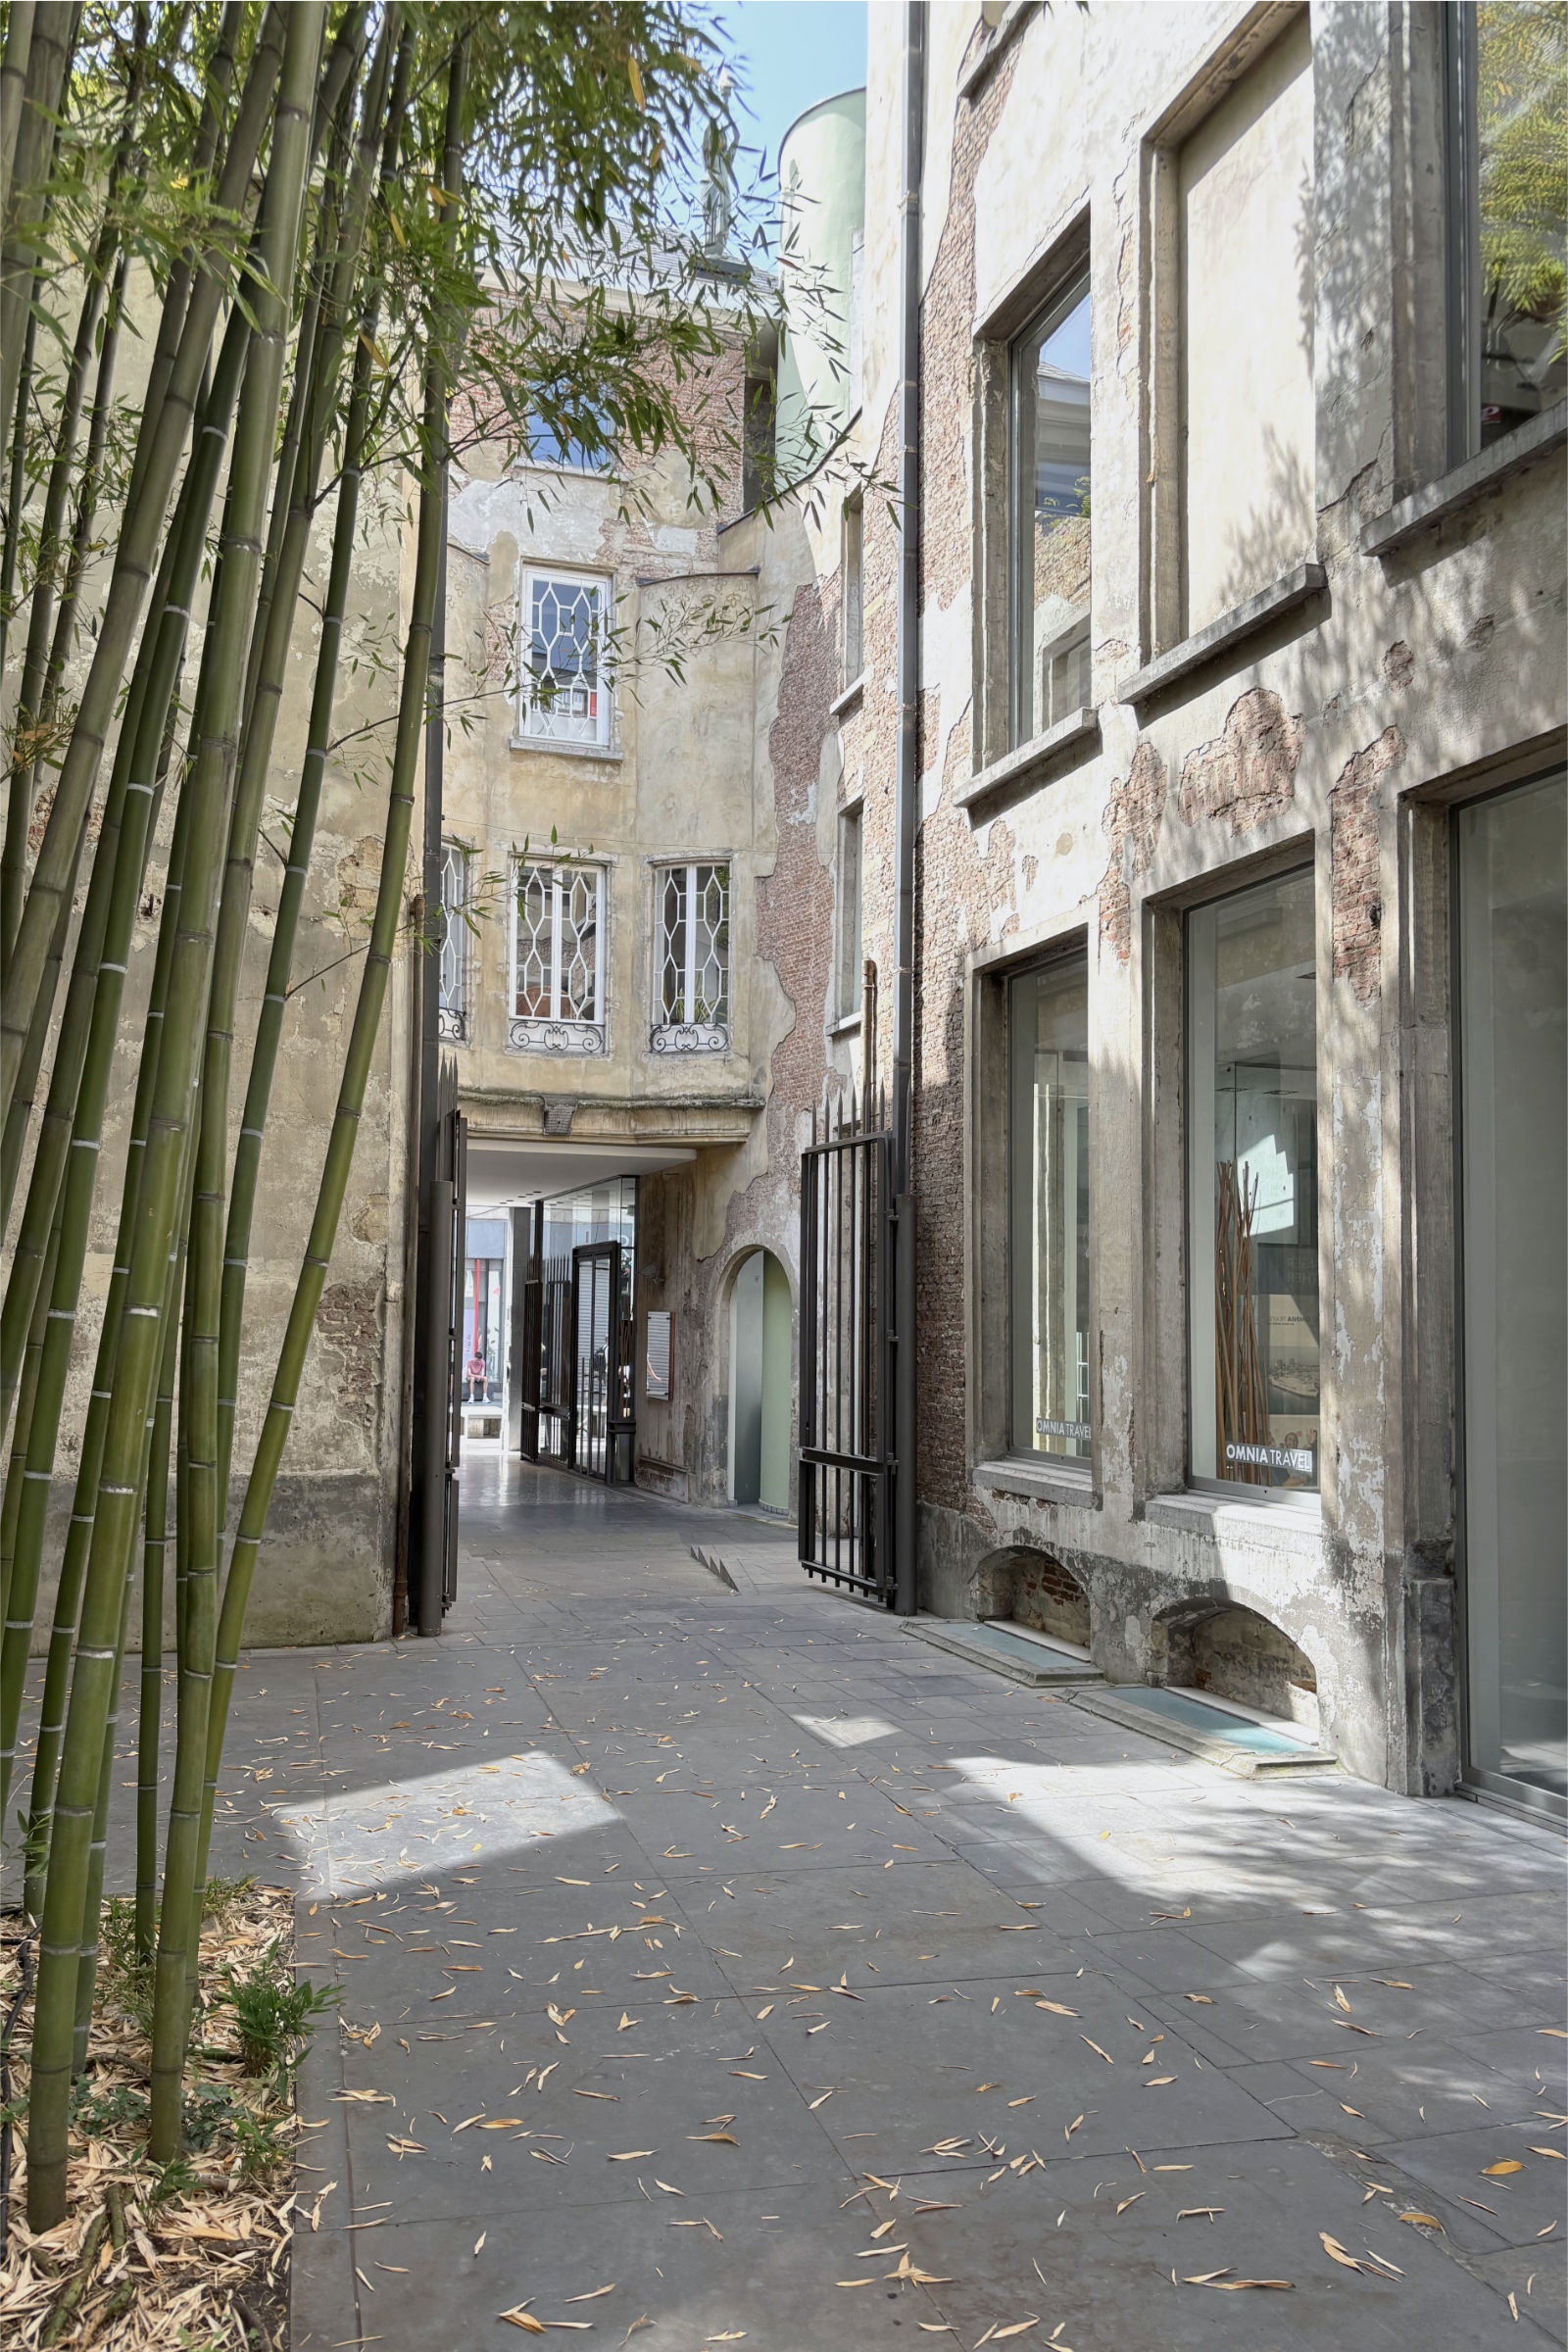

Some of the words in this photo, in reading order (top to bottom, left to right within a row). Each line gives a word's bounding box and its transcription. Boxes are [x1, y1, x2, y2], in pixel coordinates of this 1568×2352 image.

[1036, 1419, 1065, 1436] OMNIA
[1226, 1444, 1268, 1463] OMNIA
[1269, 1449, 1310, 1470] TRAVEL
